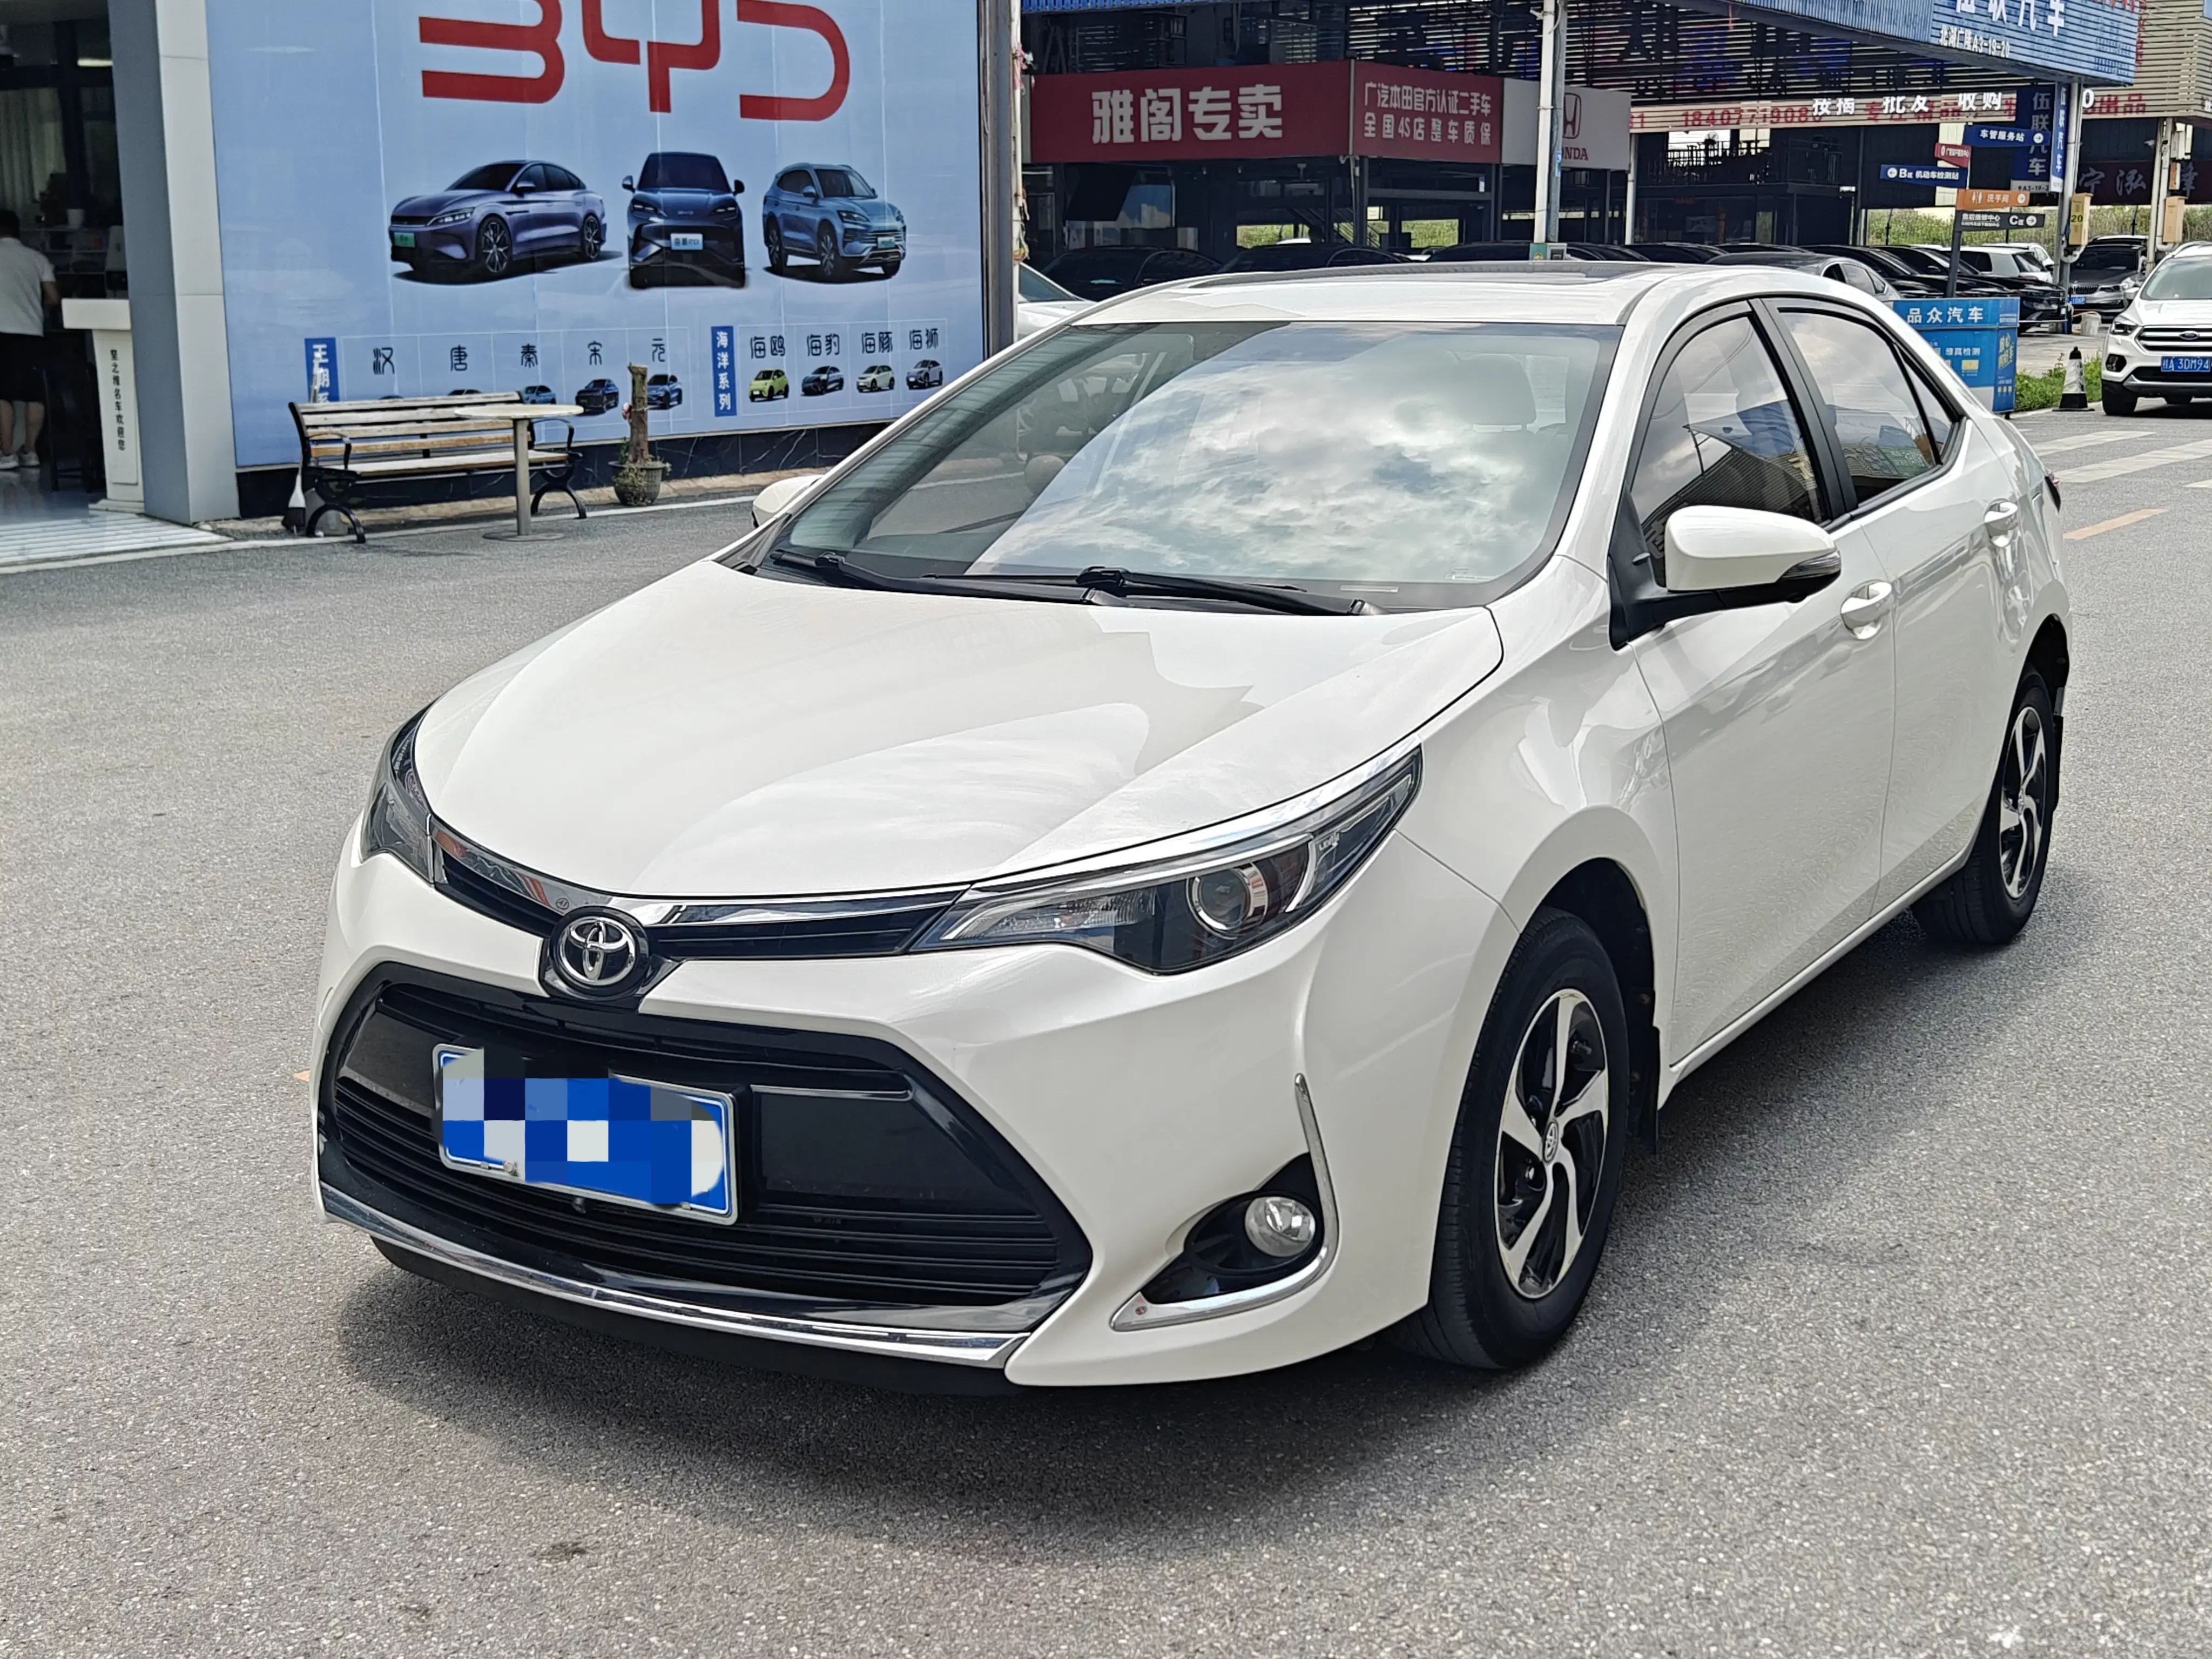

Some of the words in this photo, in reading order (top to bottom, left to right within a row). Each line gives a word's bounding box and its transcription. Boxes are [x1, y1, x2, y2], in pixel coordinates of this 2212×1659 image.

[1091, 83, 1283, 145] 雅阁专卖
[1364, 82, 1492, 117] 广汽本田官方认证二手车
[1364, 111, 1491, 145] 全国4S店整车质保
[1562, 146, 1588, 161] NDA
[1987, 193, 2009, 204] 洗手间
[2009, 215, 2024, 226] C区
[2071, 214, 2083, 222] 20
[1907, 307, 1984, 323] 品众汽车
[373, 347, 395, 375] 汉
[450, 345, 468, 372] 唐
[521, 343, 538, 368] 秦
[588, 340, 603, 366] 宋
[651, 338, 666, 362] 元
[750, 335, 785, 359] 海鸥
[806, 333, 840, 357] 海豹
[861, 331, 893, 354] 海豚
[909, 327, 939, 350] 海狮
[716, 331, 731, 411] 海洋系列
